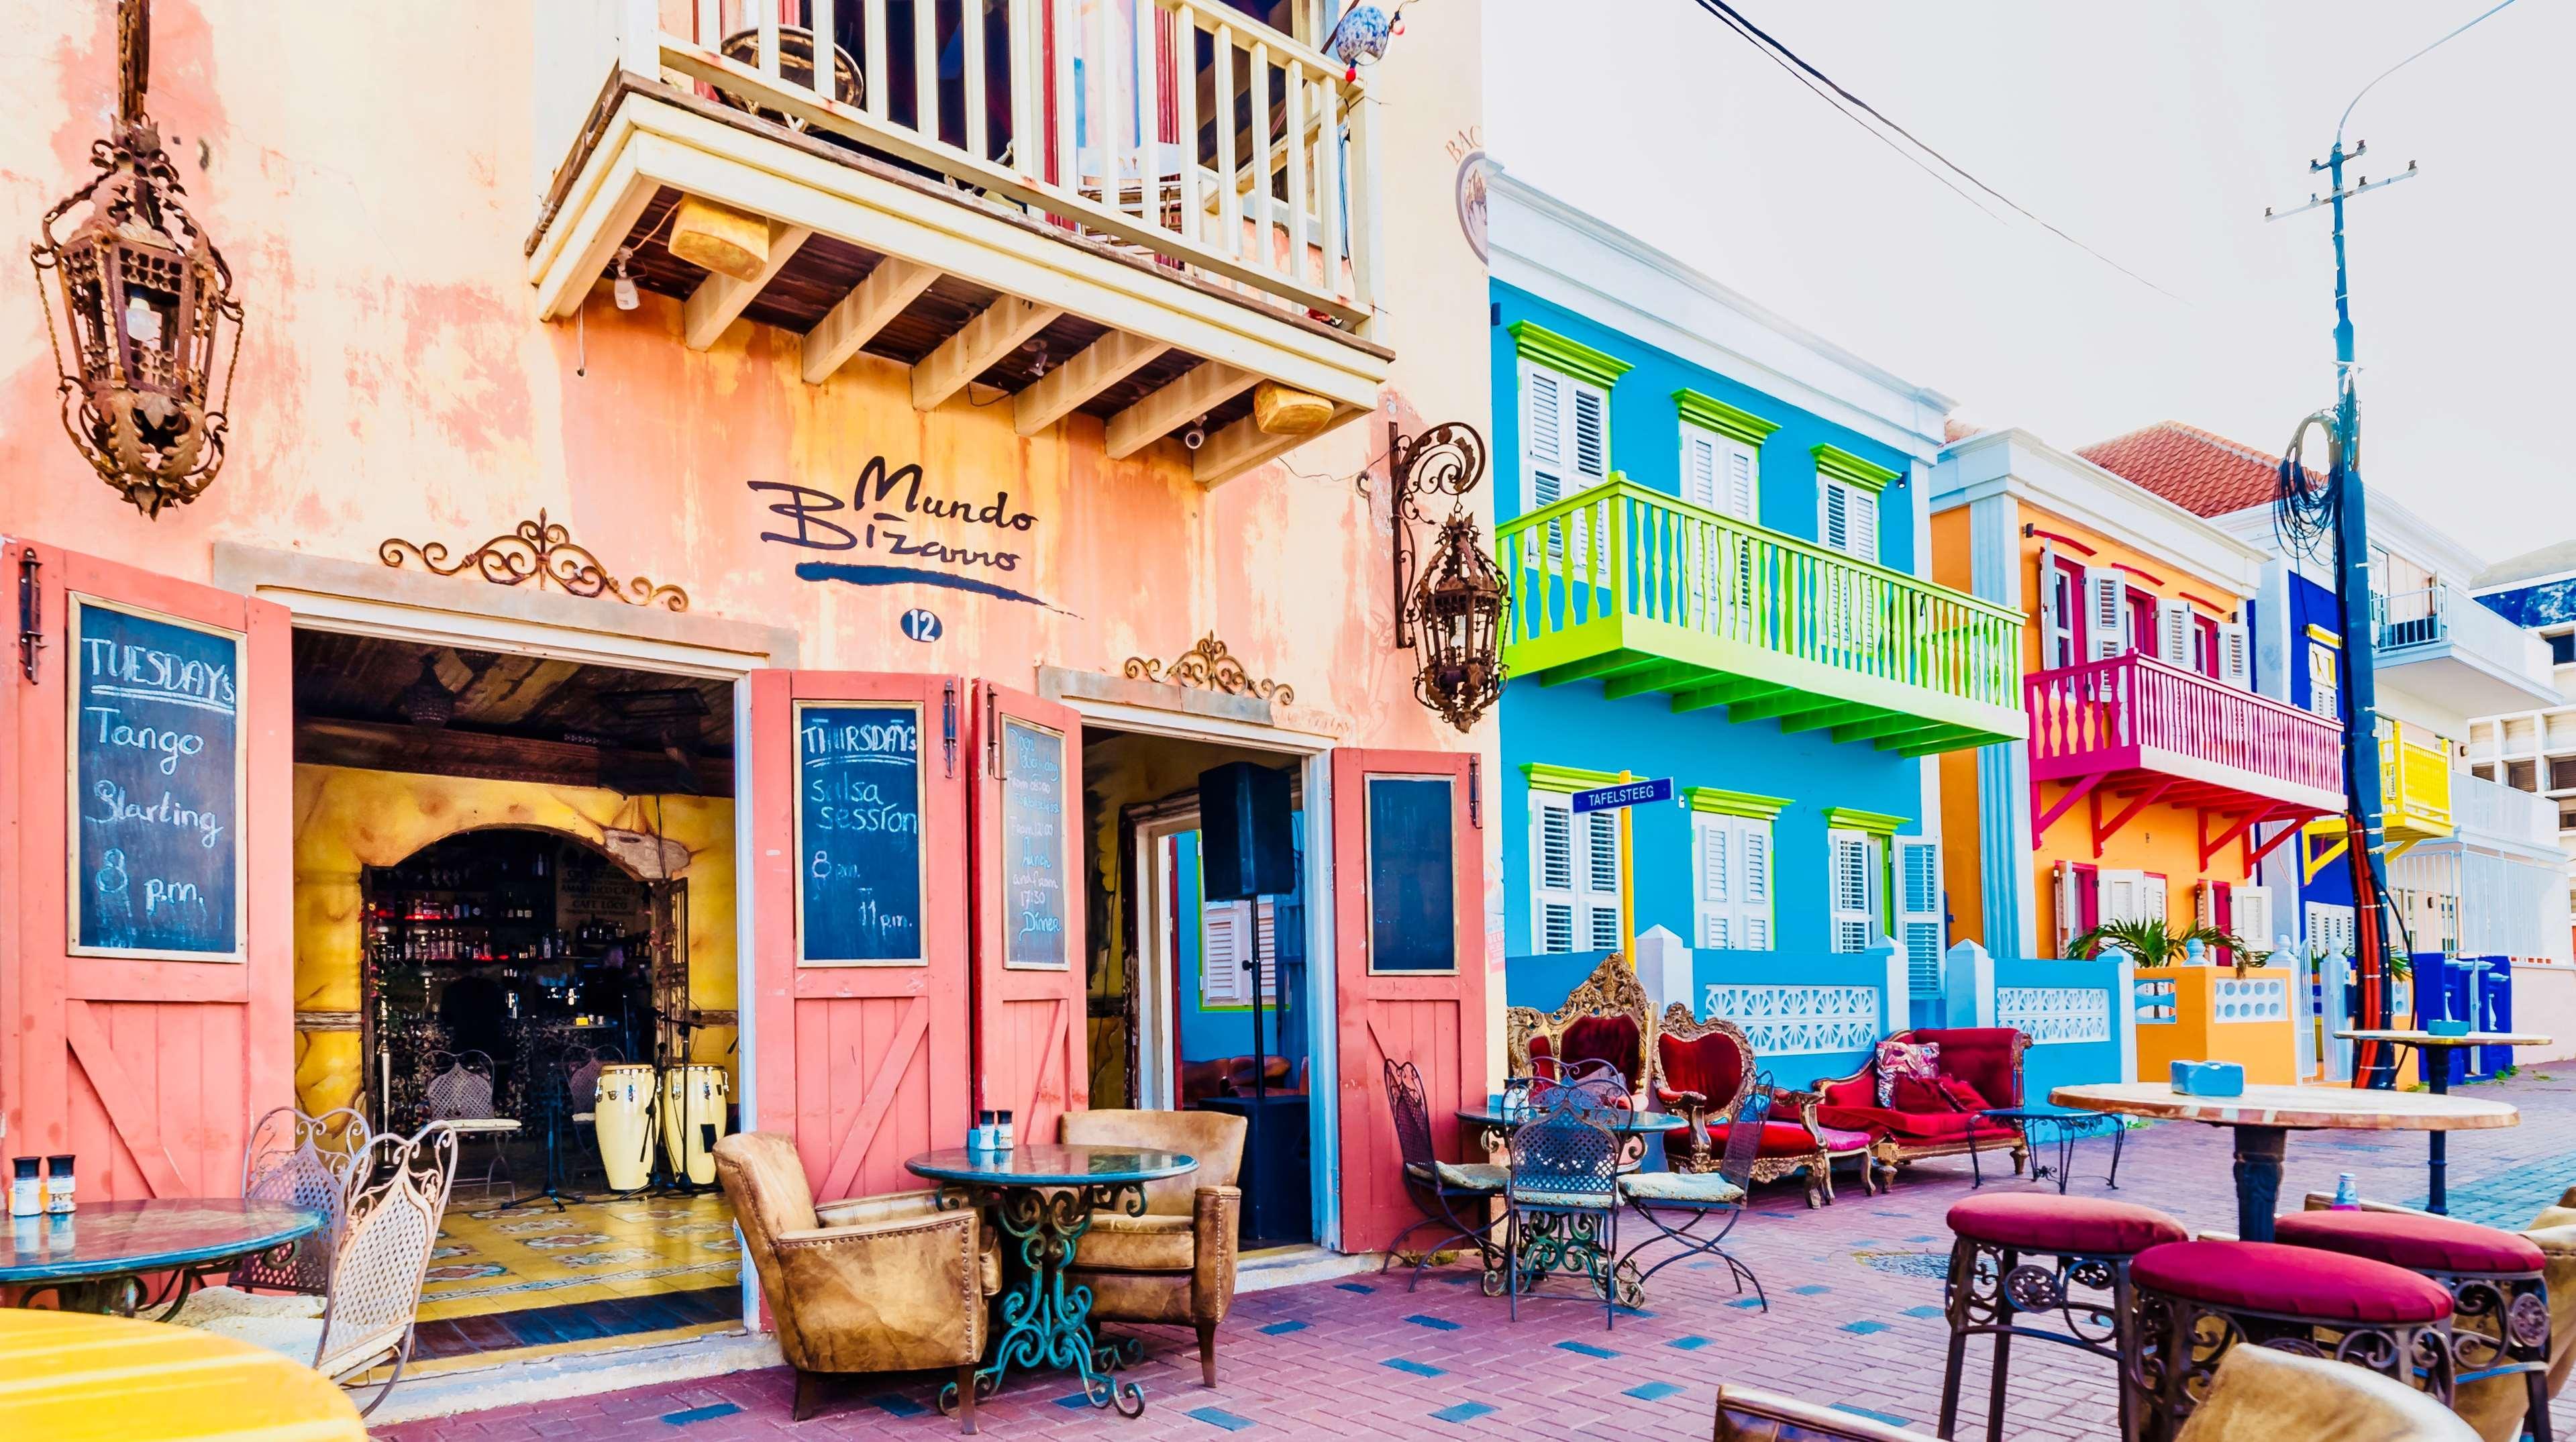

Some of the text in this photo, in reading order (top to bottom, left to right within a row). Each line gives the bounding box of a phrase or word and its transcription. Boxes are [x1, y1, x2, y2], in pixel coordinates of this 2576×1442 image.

[854, 455, 1039, 531] Mundo
[747, 480, 1022, 572] Bizarro
[910, 609, 935, 642] 12
[85, 706, 204, 775] Tango
[85, 779, 224, 848] Starting
[1588, 785, 1654, 807] TAFELSTEEG
[95, 847, 128, 893] 8
[811, 850, 832, 878] 8
[858, 898, 876, 929] 11
[1020, 890, 1047, 910] 17:30
